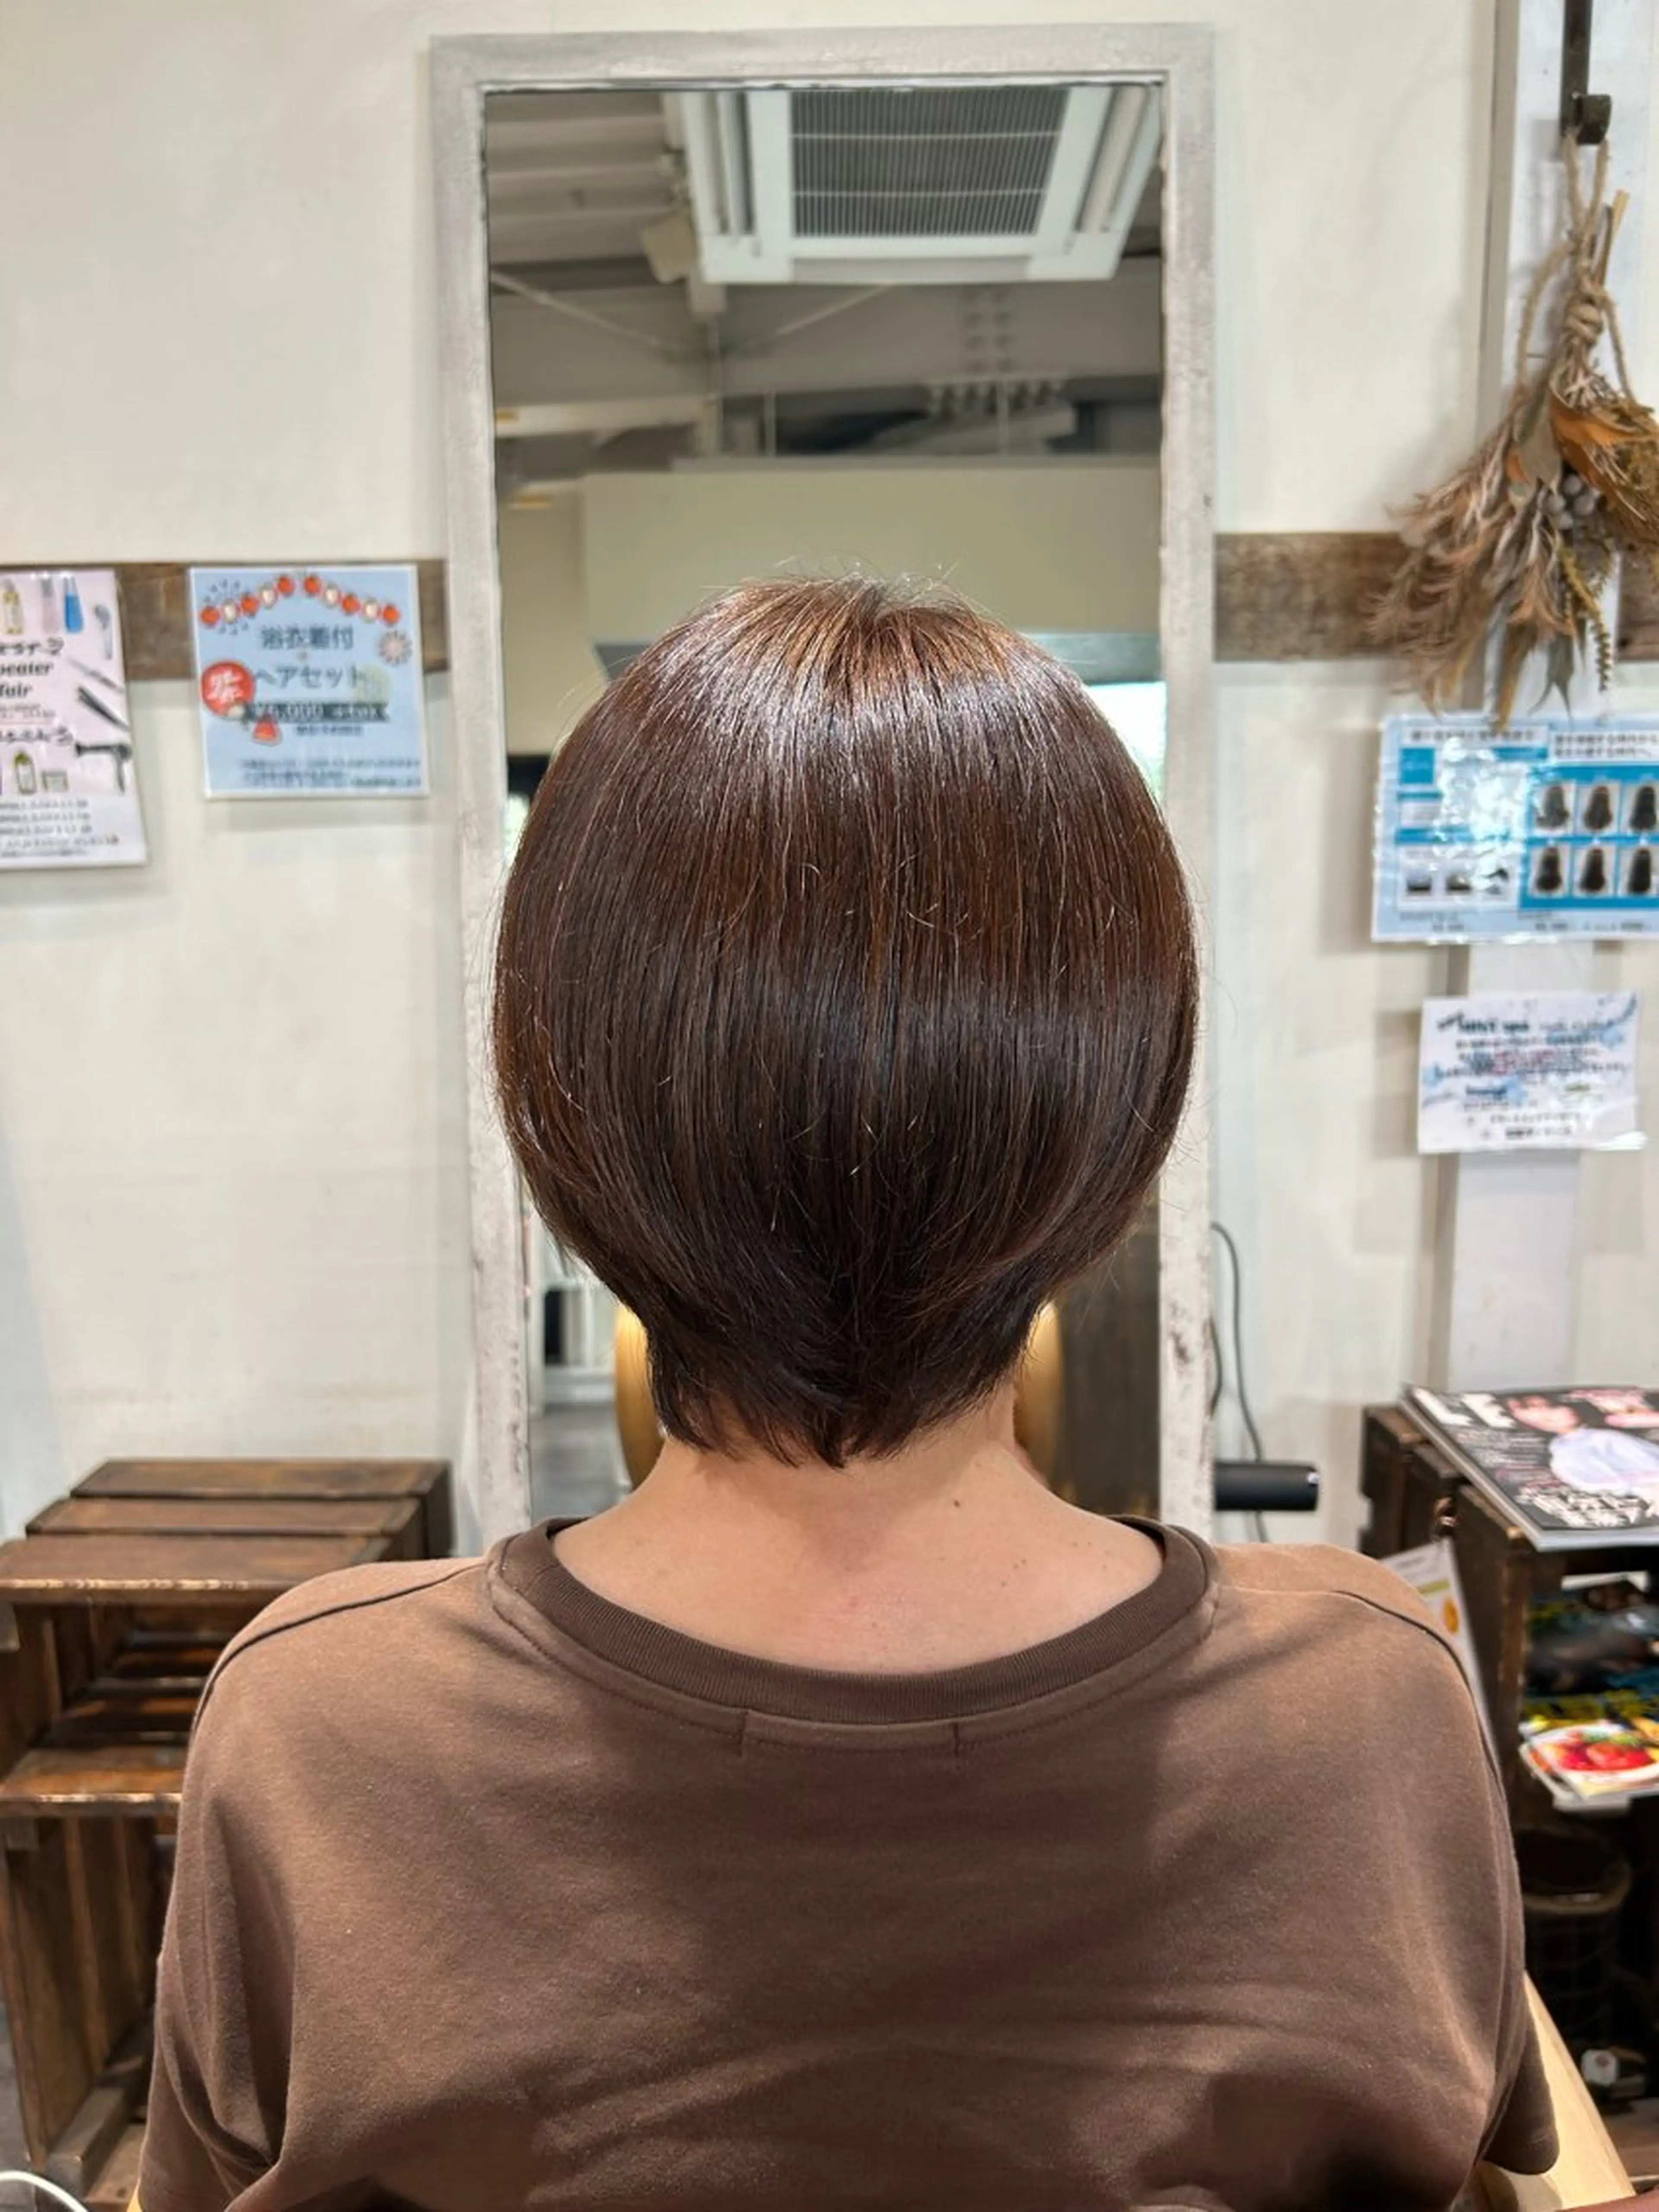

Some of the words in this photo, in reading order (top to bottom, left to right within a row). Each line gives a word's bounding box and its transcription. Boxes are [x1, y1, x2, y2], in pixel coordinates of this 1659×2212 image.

[256, 664, 366, 689] ヘアセット
